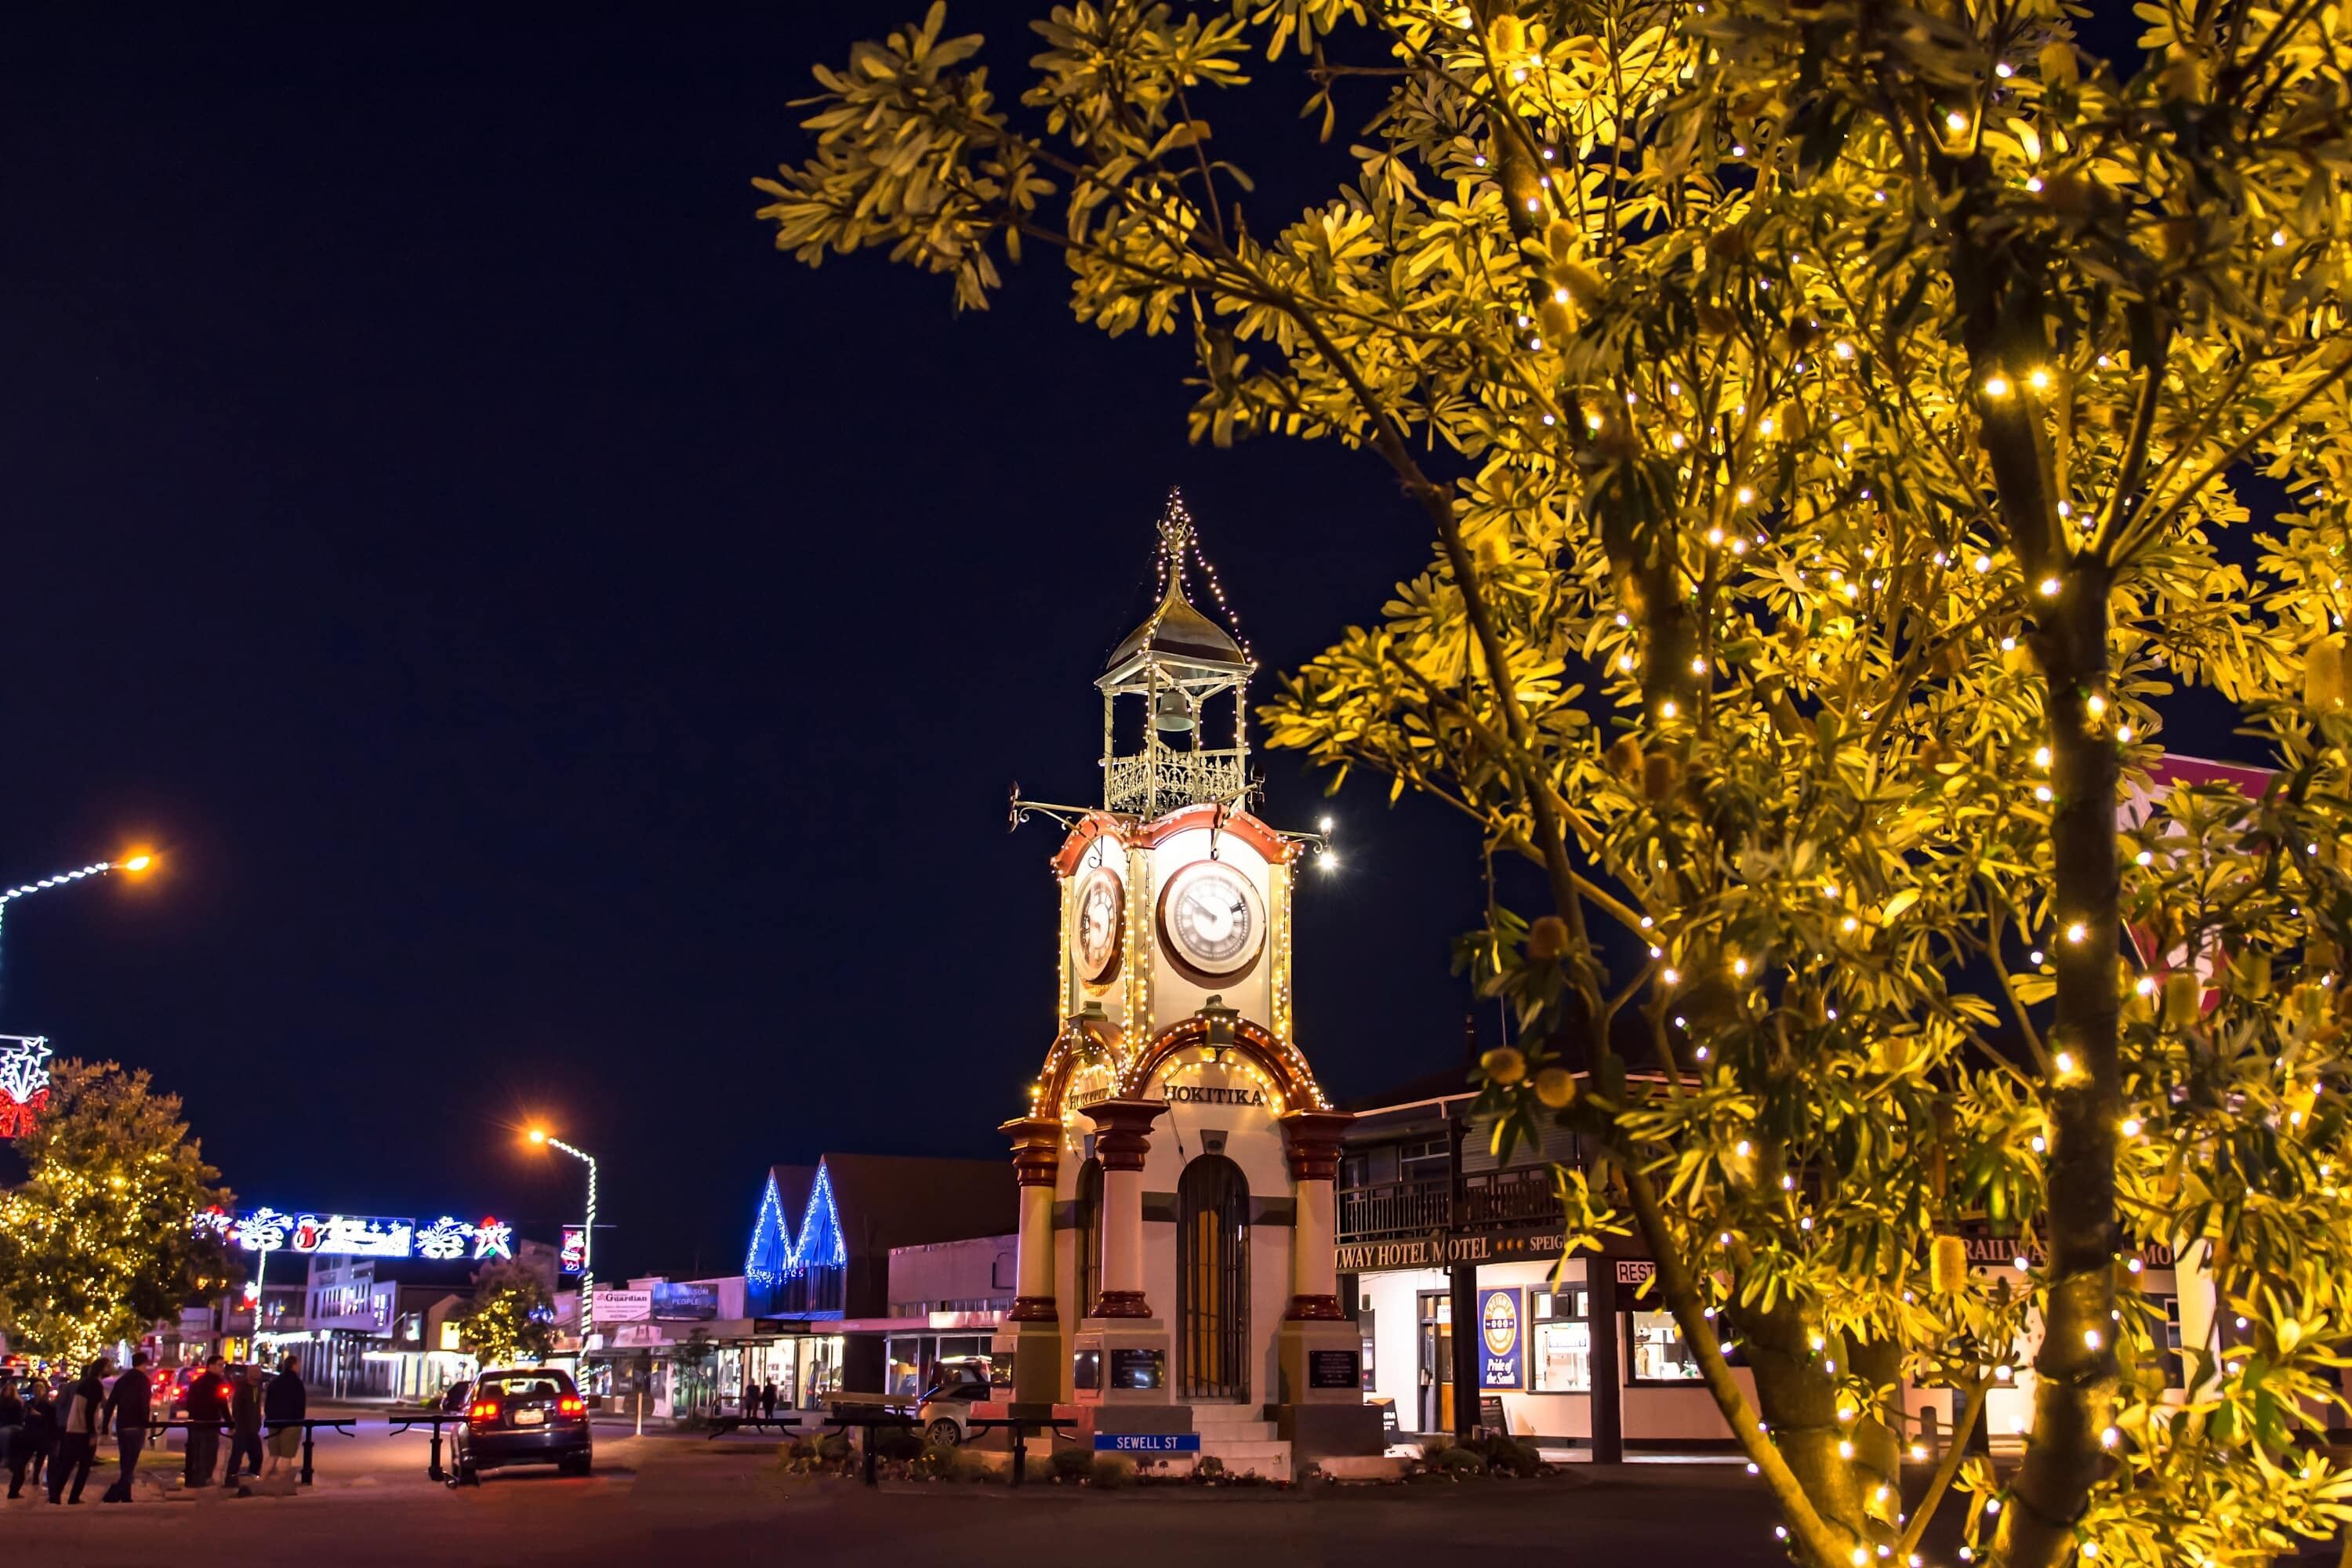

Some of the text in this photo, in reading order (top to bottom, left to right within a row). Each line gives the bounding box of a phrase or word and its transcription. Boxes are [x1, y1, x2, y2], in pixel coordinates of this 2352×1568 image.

[1165, 1085, 1264, 1106] HOKITIKA
[1334, 1247, 1374, 1269] LWAY
[1377, 1242, 1428, 1266] HOTEL
[1432, 1236, 1490, 1262] MOTEL
[1618, 1263, 1655, 1281] REST
[605, 1293, 647, 1301] Guardian
[1486, 1358, 1514, 1374] Pride of
[1116, 1436, 1178, 1449] SEWELL ST
